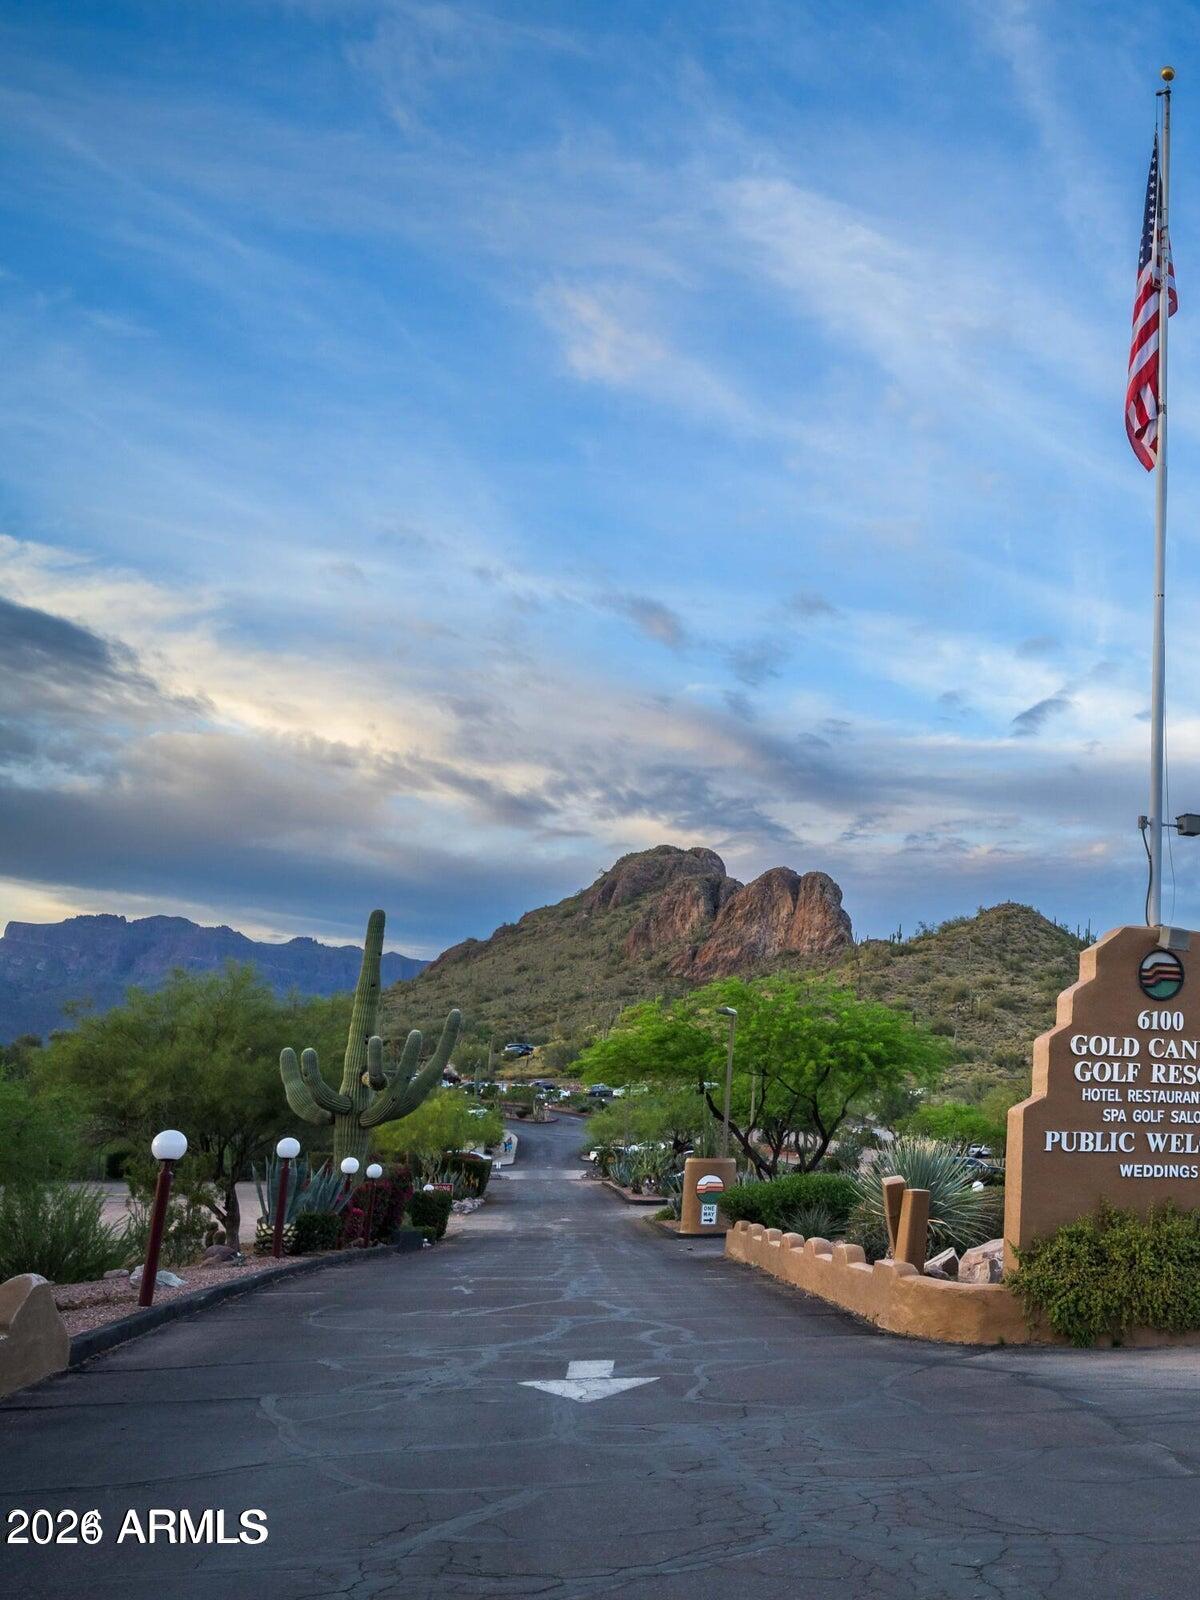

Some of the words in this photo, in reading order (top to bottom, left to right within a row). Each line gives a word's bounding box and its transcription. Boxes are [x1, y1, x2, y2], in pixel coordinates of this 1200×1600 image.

[1137, 1009, 1184, 1031] 6100
[1070, 1034, 1140, 1057] GOLD
[1074, 1061, 1141, 1083] GOLF
[1081, 1087, 1123, 1102] HOTEL
[1102, 1108, 1127, 1122] SPA
[1132, 1109, 1165, 1123] GOLF
[1044, 1130, 1136, 1153] PUBLIC
[1119, 1164, 1199, 1178] WEDDINGS
